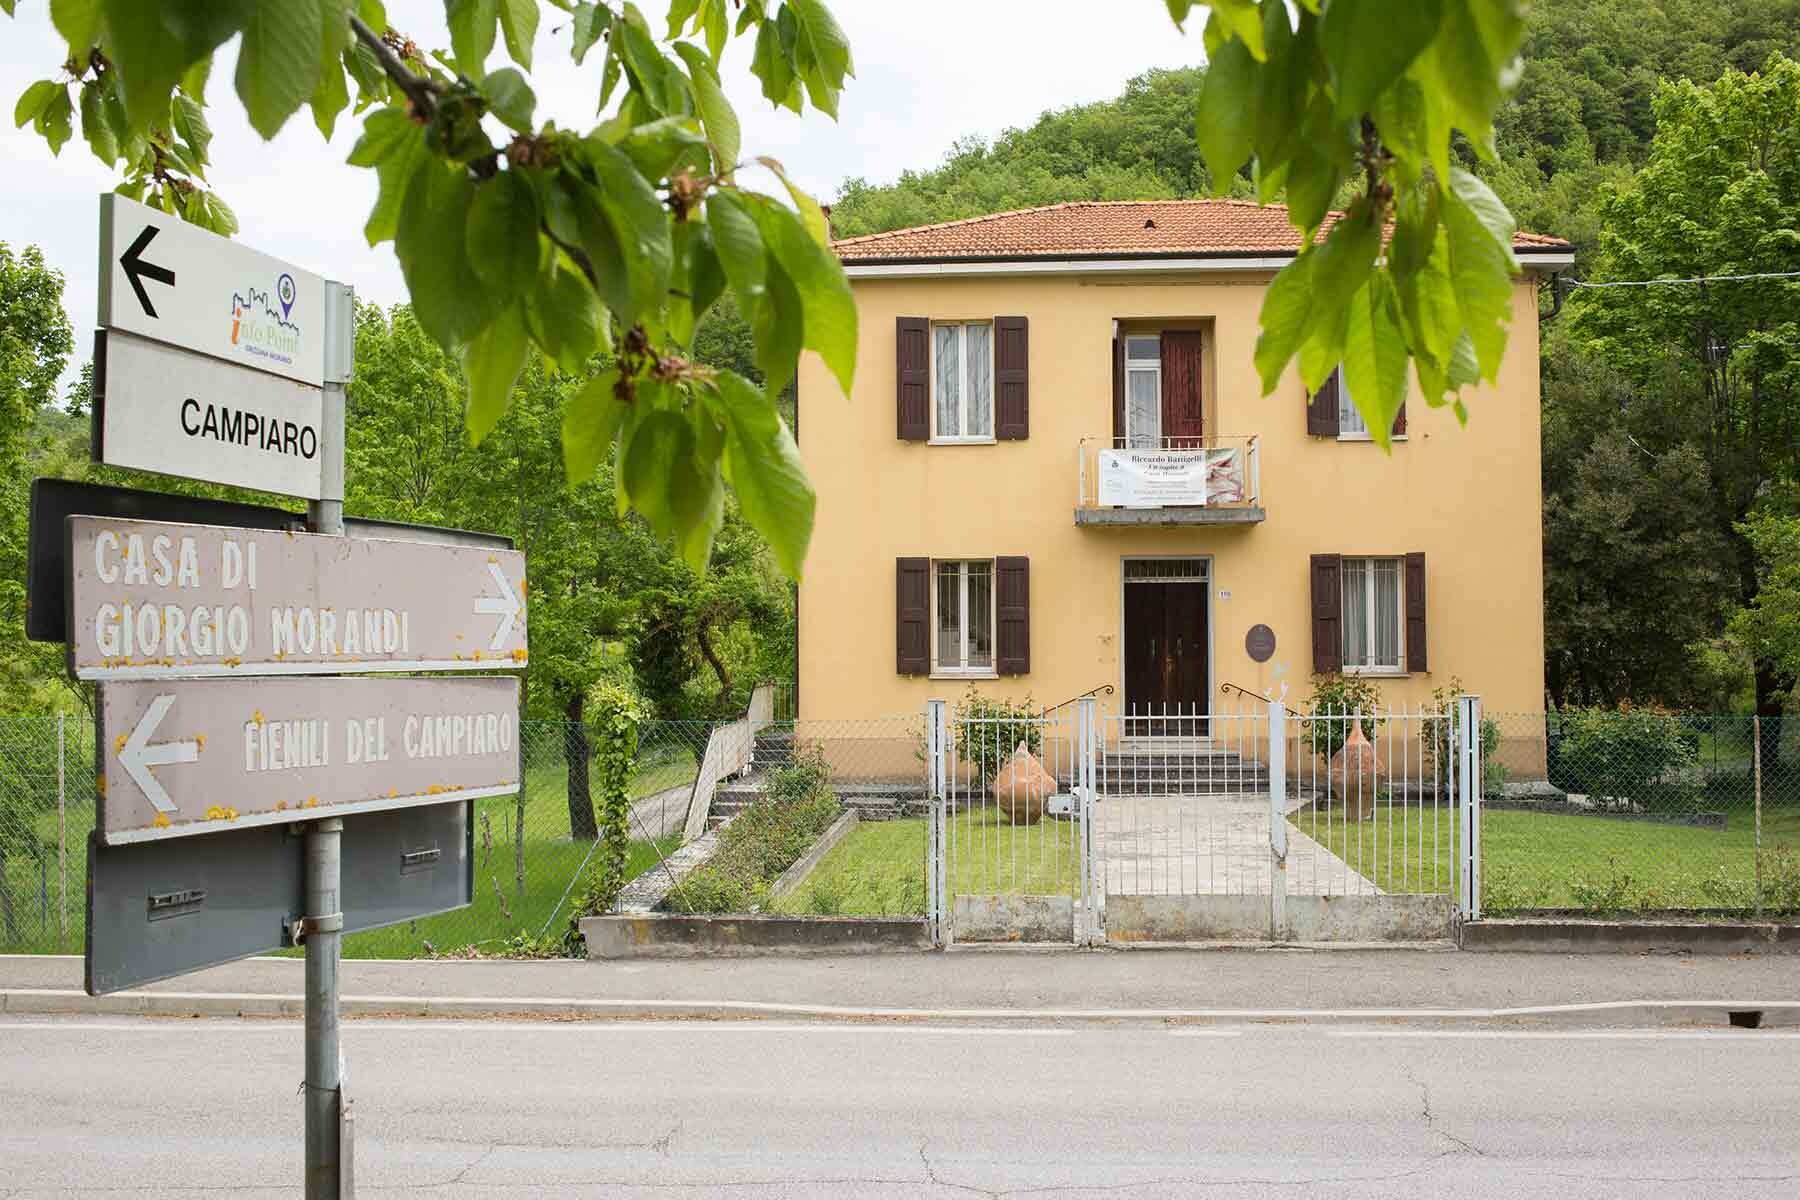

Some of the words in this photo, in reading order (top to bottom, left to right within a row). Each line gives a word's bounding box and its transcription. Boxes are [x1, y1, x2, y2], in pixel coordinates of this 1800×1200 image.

[181, 398, 317, 459] CAMPIARO
[95, 531, 201, 588] CASA
[222, 540, 257, 590] DI
[95, 603, 249, 657] GIORGIO
[271, 606, 409, 655] MORANDI
[244, 719, 329, 771] FIENILI
[345, 717, 390, 764] DEL
[403, 713, 512, 758] CAMPIARO
